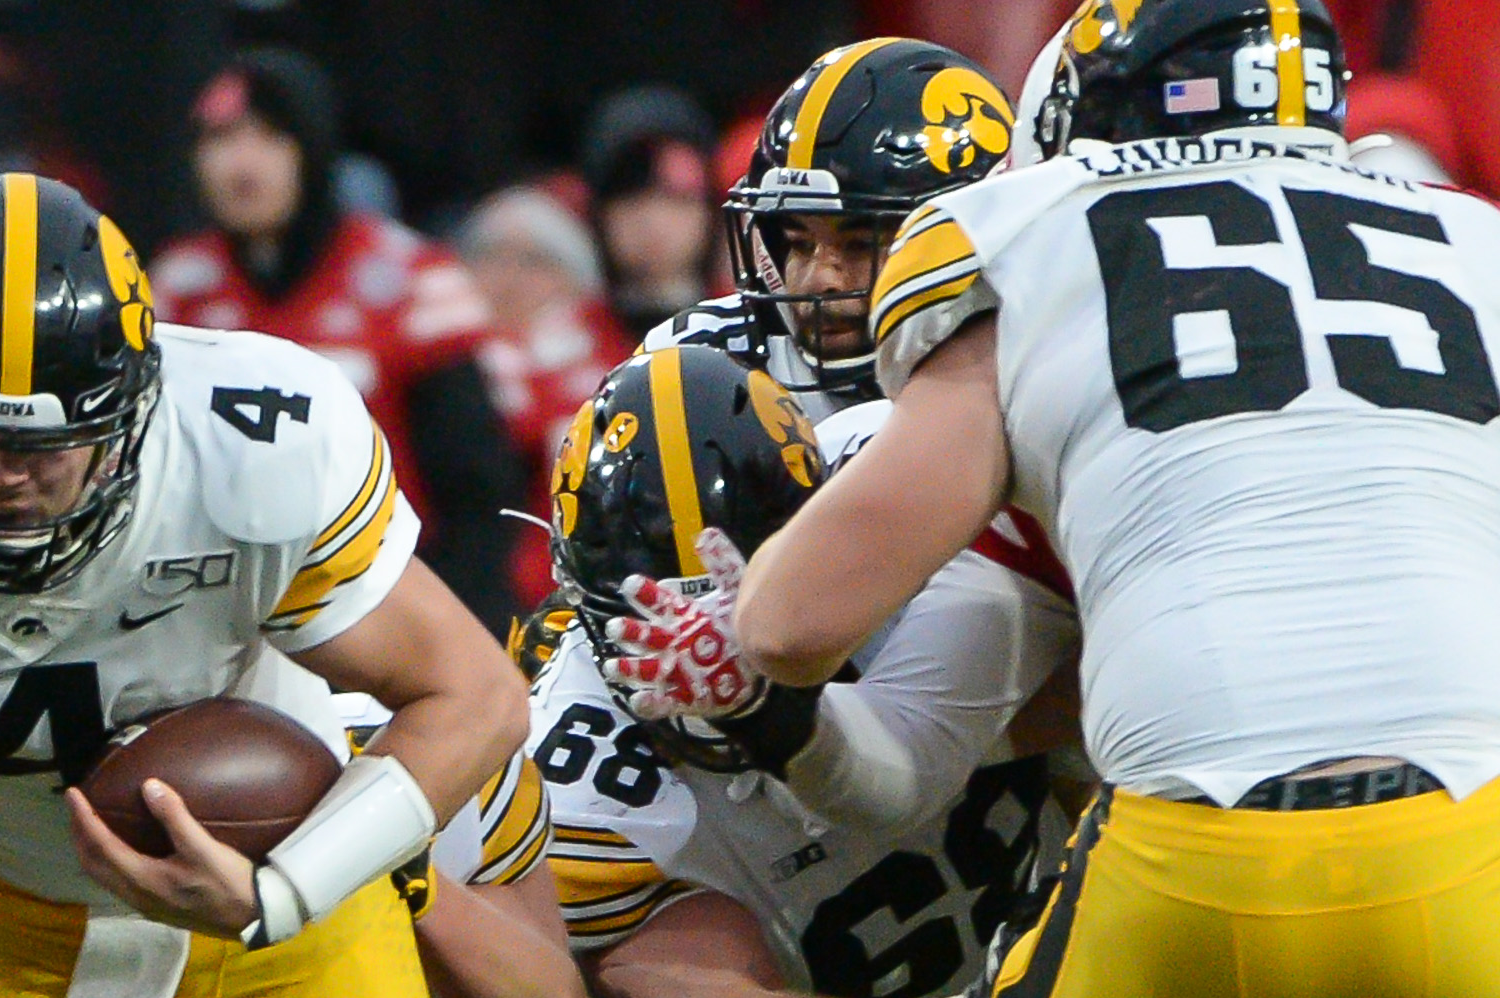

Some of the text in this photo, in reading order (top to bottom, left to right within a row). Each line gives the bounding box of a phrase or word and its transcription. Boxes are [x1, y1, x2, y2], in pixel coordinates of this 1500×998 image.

[1087, 180, 1500, 434] 65
[210, 385, 312, 444] 4
[533, 702, 662, 808] 68
